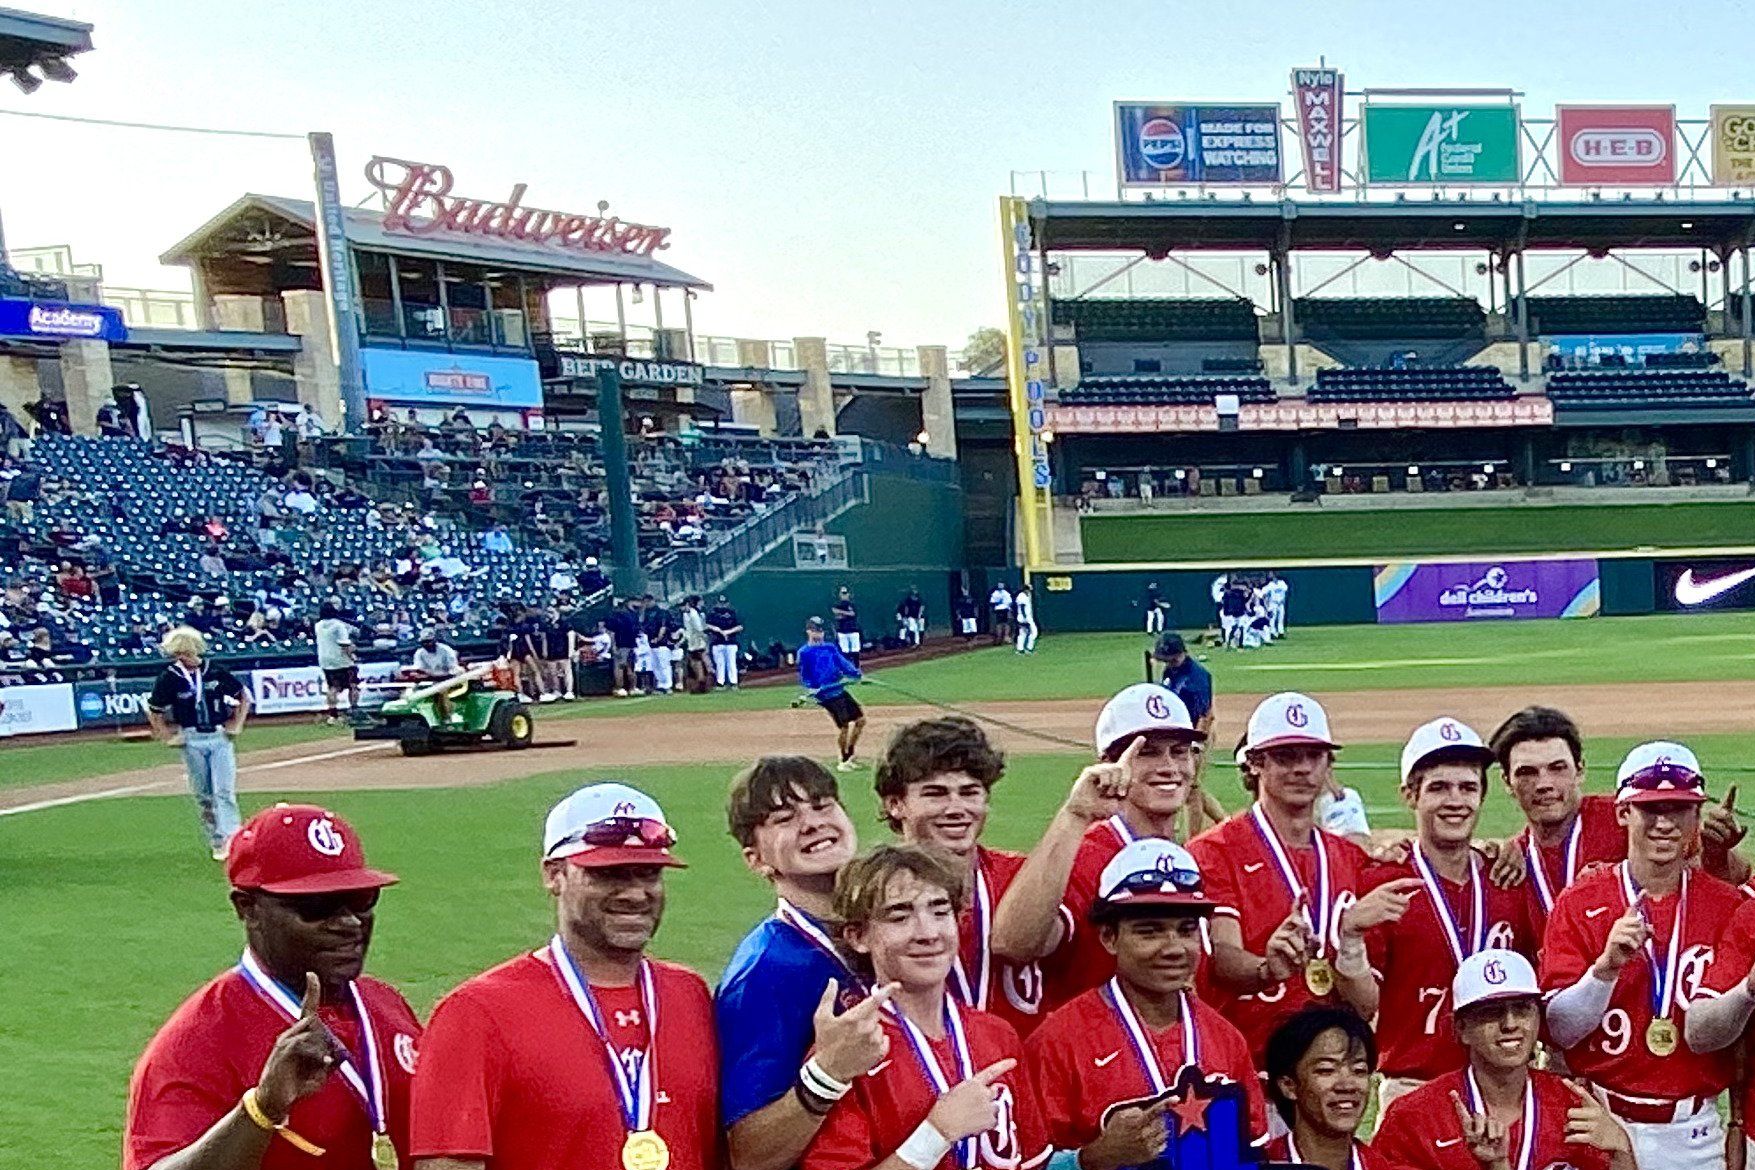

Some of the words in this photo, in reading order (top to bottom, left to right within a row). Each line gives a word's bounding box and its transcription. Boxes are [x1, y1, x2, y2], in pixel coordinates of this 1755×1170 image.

[1201, 135, 1276, 148] EXPRESS
[1303, 91, 1334, 191] MAXWELL
[364, 154, 672, 257] Budweiser
[560, 356, 616, 378] BEE
[618, 360, 703, 384] GARDEN
[1439, 590, 1467, 605] dell
[1469, 589, 1538, 604] children's
[1418, 987, 1449, 1035] 7
